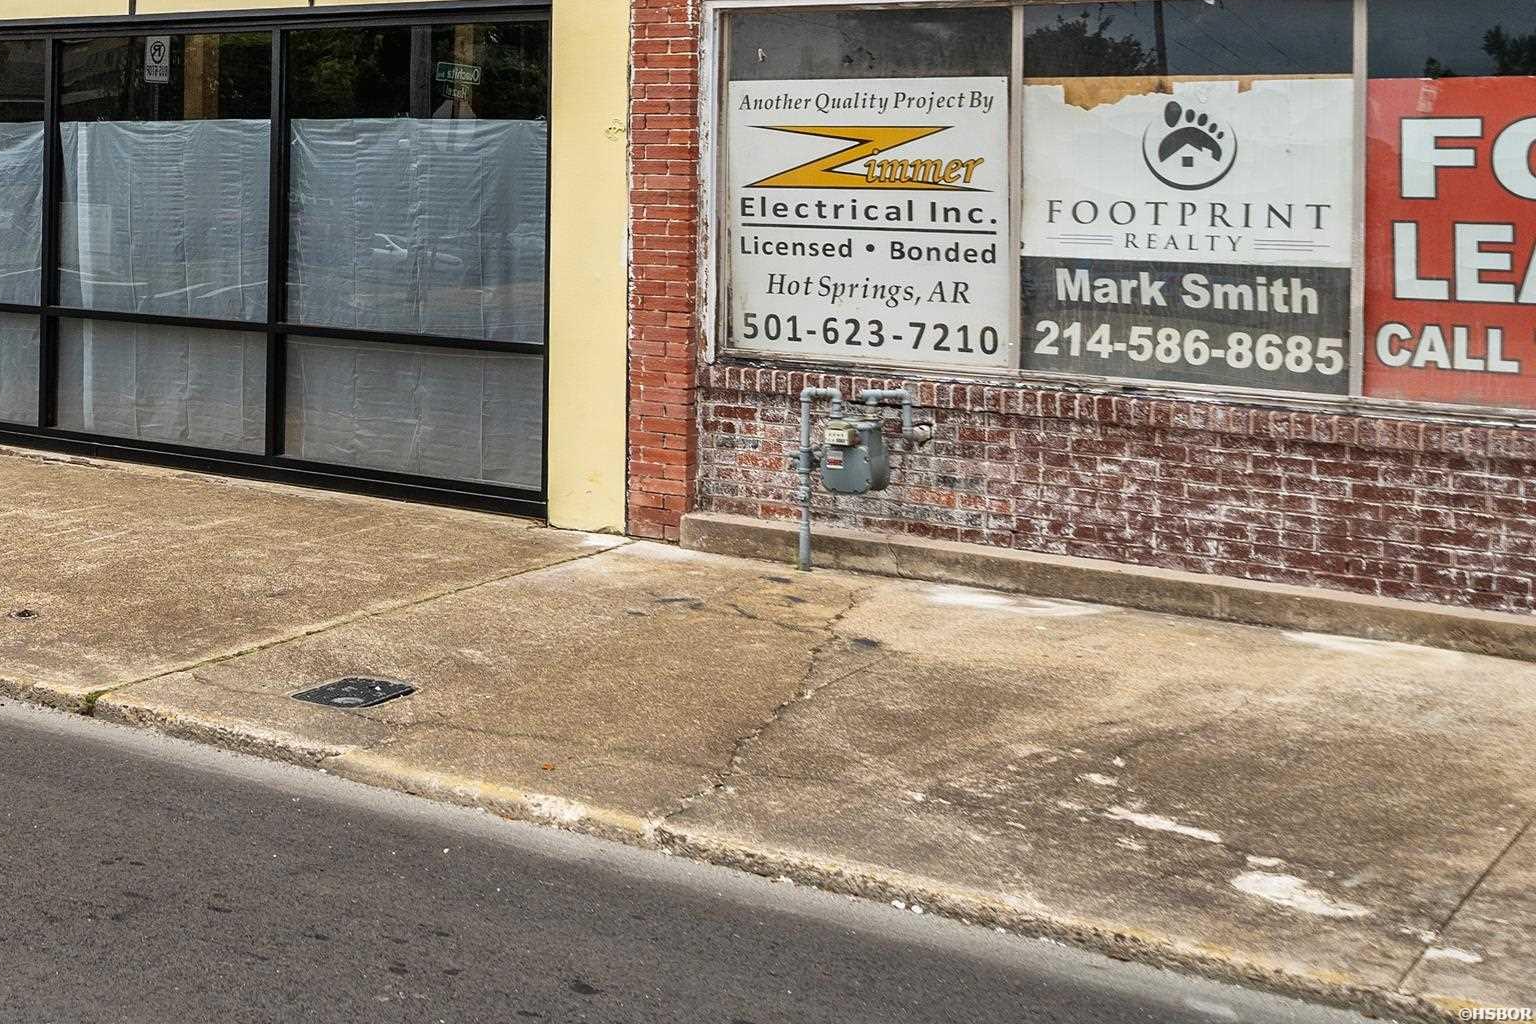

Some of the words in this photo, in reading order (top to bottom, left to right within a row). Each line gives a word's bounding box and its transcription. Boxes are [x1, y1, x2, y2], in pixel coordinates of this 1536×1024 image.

[738, 92, 812, 111] Another
[814, 91, 889, 114] Quality
[892, 91, 966, 114] Project
[968, 90, 995, 113] By
[743, 125, 995, 193] Zimmer
[740, 195, 914, 223] Electrical
[929, 201, 998, 225] Inc.
[1046, 199, 1332, 230] FOOTPRINT
[740, 235, 853, 258] Licensed
[889, 240, 997, 264] Bonded
[1124, 232, 1243, 252] REALTY
[1393, 220, 1536, 305] LE
[765, 273, 815, 296] Hot
[818, 275, 921, 308] Springs,
[928, 280, 971, 305] AR
[1055, 268, 1168, 307] Mark
[1180, 273, 1319, 315] Smith
[743, 312, 999, 355] 501-623-7210
[1034, 319, 1345, 375] 214-586-8685
[1375, 322, 1520, 374] CALL
